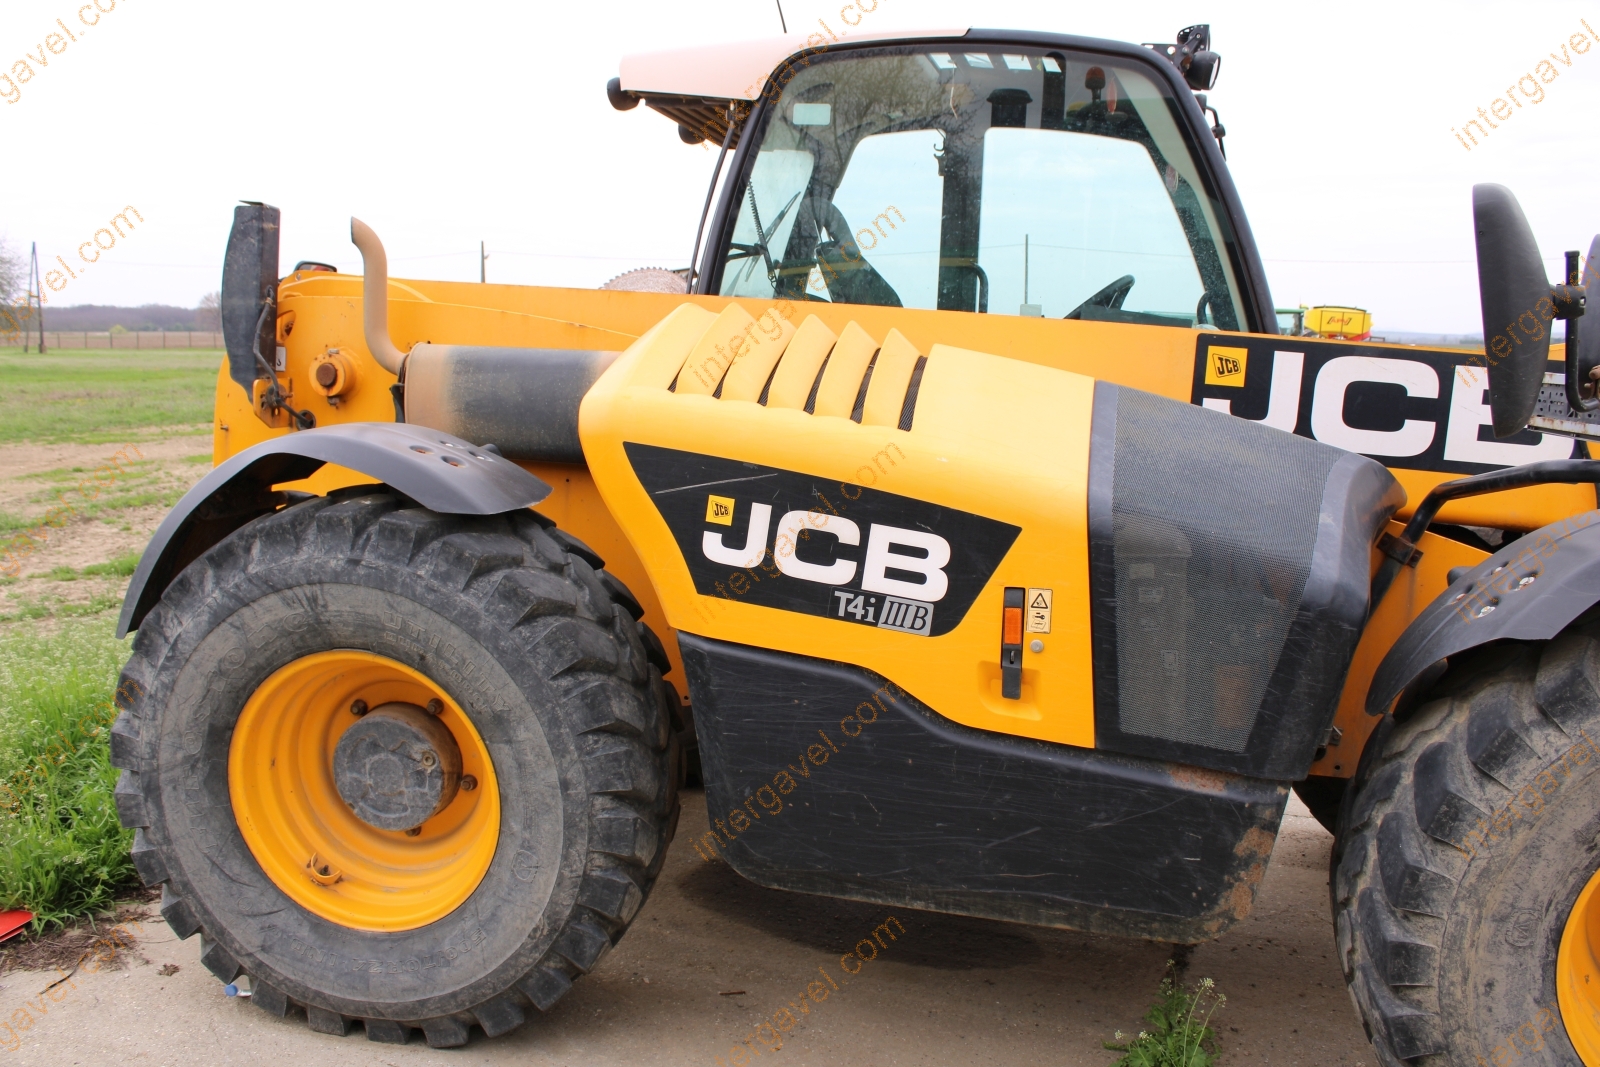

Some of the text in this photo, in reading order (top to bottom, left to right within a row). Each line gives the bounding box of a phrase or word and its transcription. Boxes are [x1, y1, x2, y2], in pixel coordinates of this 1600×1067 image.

[1216, 355, 1240, 376] JCB
[714, 502, 729, 517] JCB
[702, 502, 951, 601] JCB
[834, 590, 876, 623] T4i
